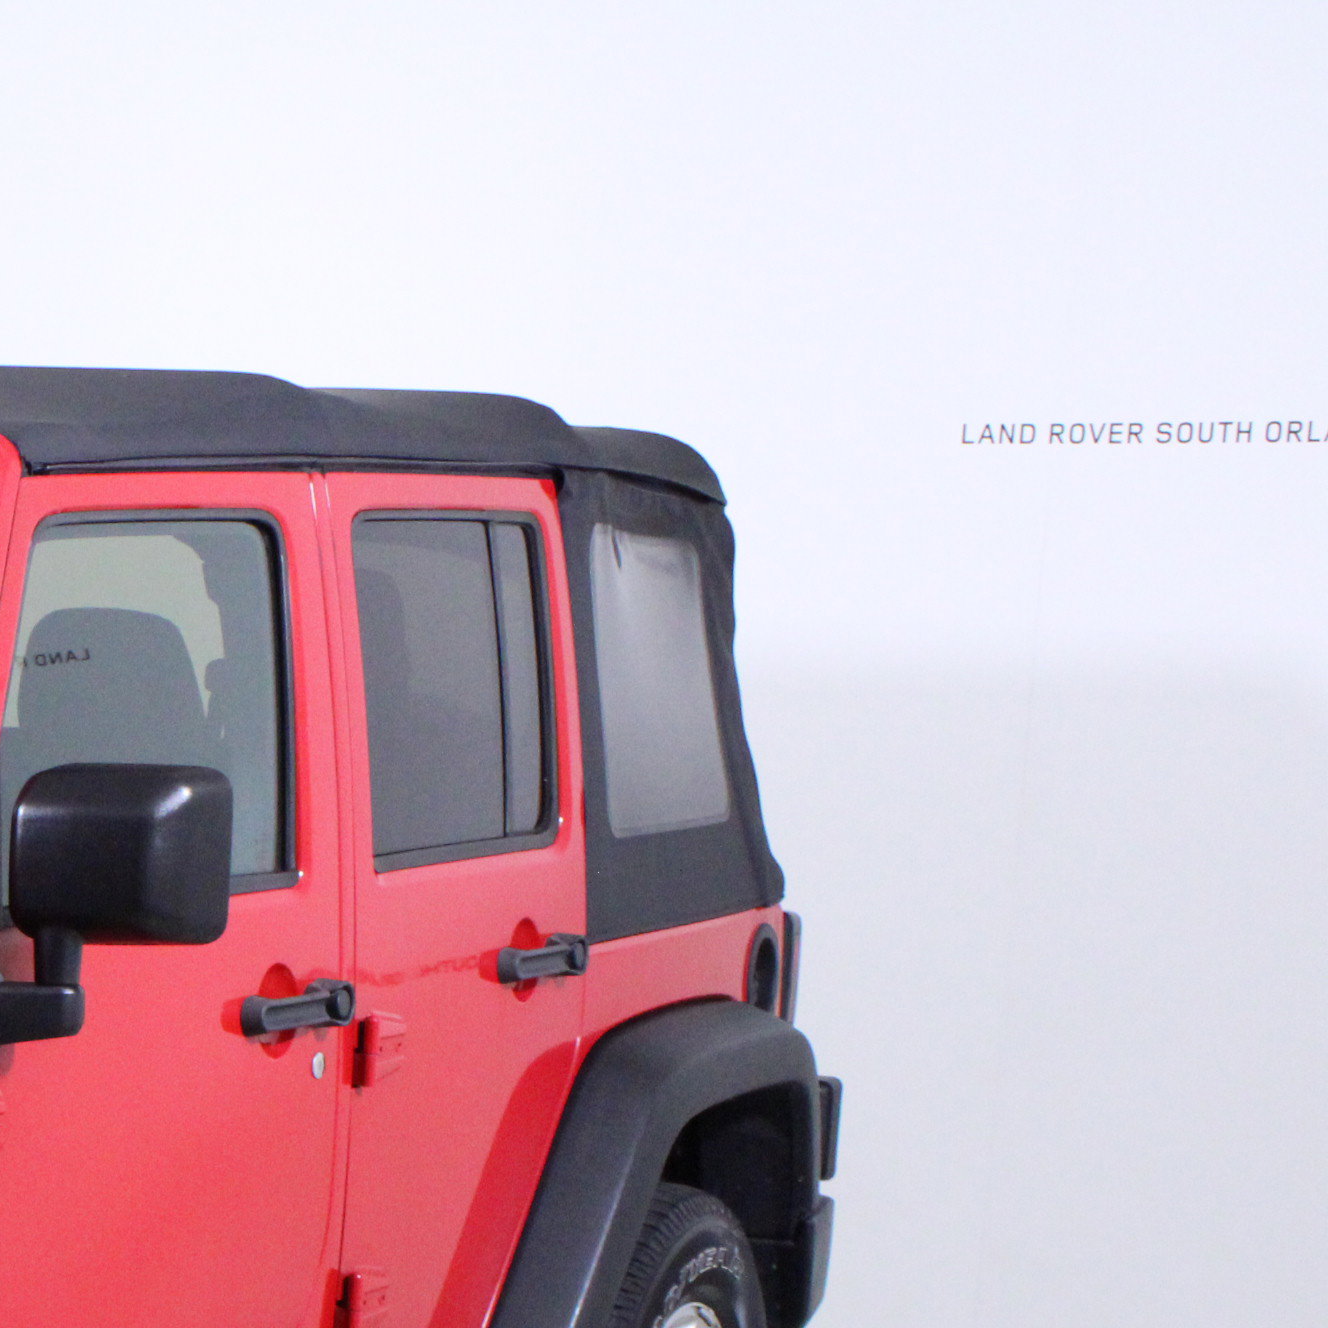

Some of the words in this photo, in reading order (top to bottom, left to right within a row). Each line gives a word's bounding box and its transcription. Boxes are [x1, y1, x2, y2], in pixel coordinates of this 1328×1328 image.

[961, 423, 1036, 444] LAND
[1048, 422, 1144, 445] ROVER
[1156, 421, 1253, 444] SOUTH
[1264, 420, 1328, 443] ORL
